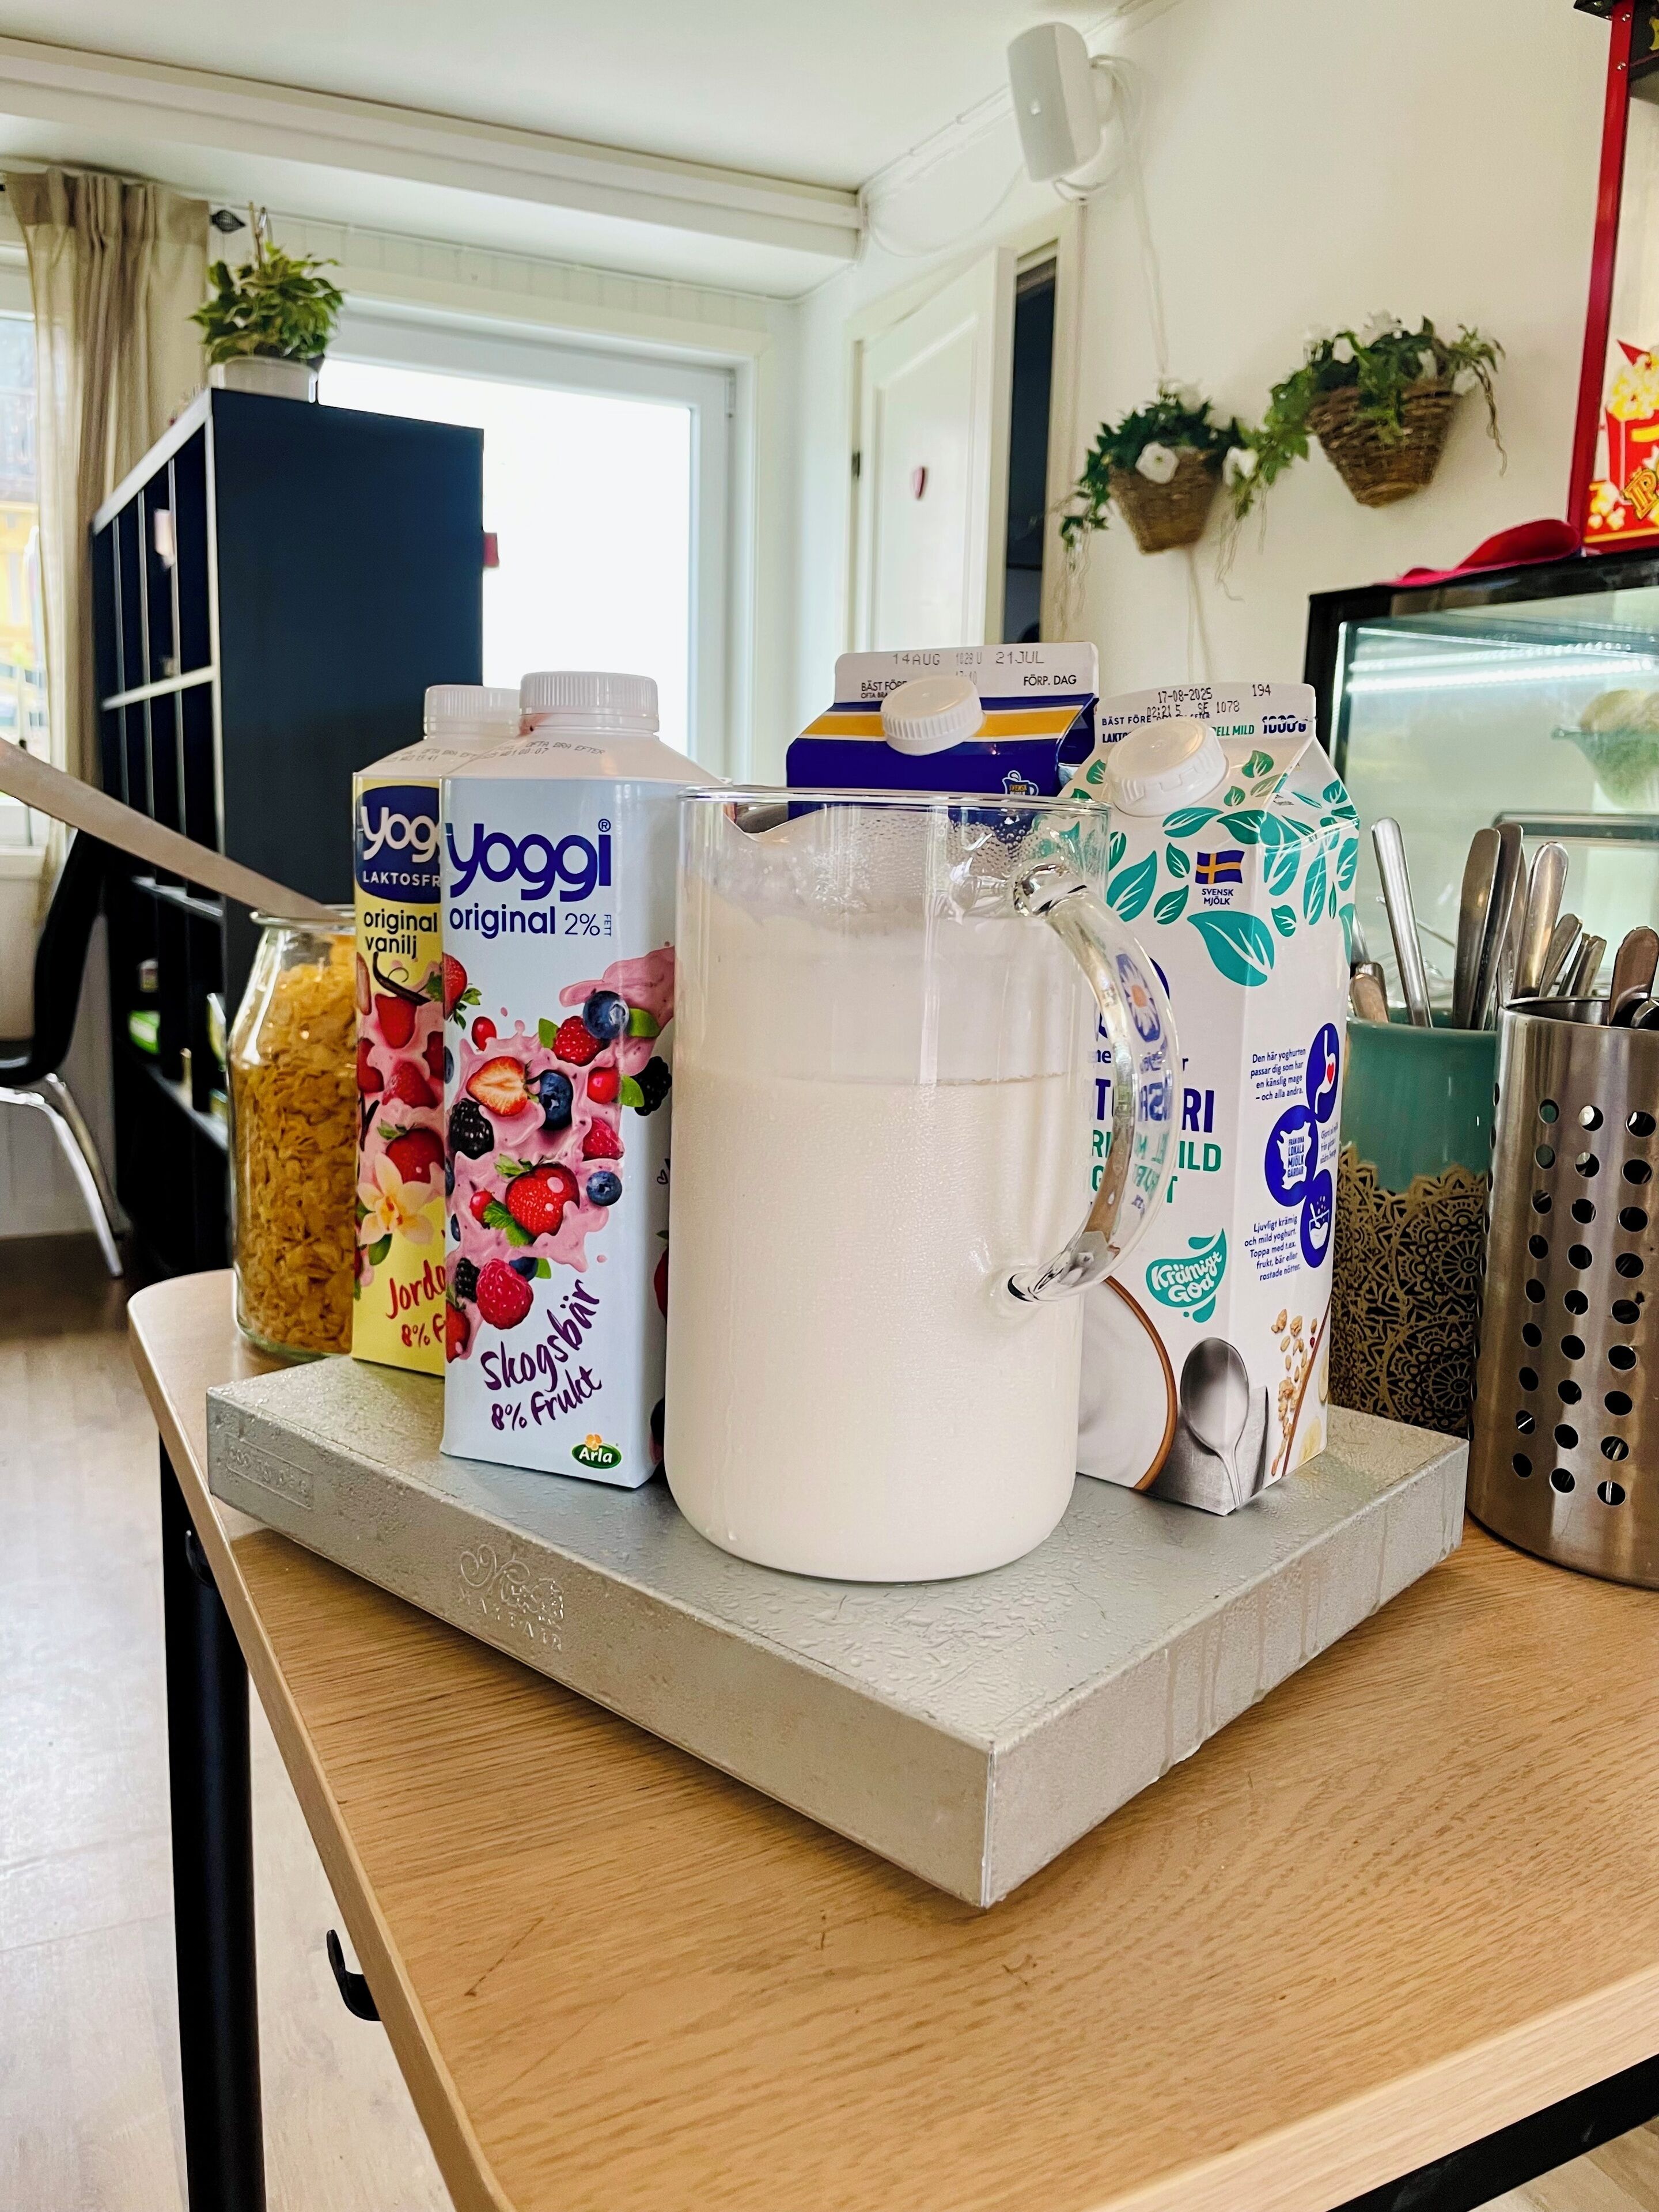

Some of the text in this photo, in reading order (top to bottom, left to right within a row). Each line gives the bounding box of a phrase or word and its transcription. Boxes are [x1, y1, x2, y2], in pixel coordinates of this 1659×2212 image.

[861, 680, 882, 691] BÄST
[1023, 674, 1077, 686] FÖRP. DAG
[1158, 687, 1213, 704] 17-08-2025
[1252, 684, 1271, 696] 194
[1216, 700, 1240, 713] 1078
[1102, 716, 1124, 726] BÄST
[1128, 714, 1152, 724] FÖRE
[1232, 725, 1255, 735] MILD
[363, 870, 441, 888] LAKTOSFR
[1202, 888, 1234, 896] SVENSK
[1203, 896, 1230, 906] MJÖLK
[363, 908, 438, 935] original
[449, 903, 601, 939] original 2%
[604, 914, 612, 937] FETT
[365, 934, 417, 960] vanilj
[1252, 1048, 1306, 1063] Den här yoghurten
[1251, 1060, 1304, 1080] passar dig som har
[1266, 1075, 1286, 1087] känslig
[1287, 1075, 1302, 1085] mage
[1262, 1090, 1273, 1101] och
[1274, 1089, 1285, 1099] alla
[1286, 1085, 1304, 1096] andra.
[1253, 1214, 1297, 1233] Ljuvligt krämig
[1244, 1228, 1297, 1247] och mild yoghurt.
[1249, 1248, 1270, 1259] Toppa
[1271, 1242, 1284, 1253] med
[1256, 1251, 1298, 1270] frukt, bär eller
[1151, 1251, 1222, 1291] Krämigt
[1260, 1263, 1301, 1281] rostade nötter.
[402, 1323, 431, 1348] 8%
[480, 1278, 600, 1393] Skogsbär
[491, 1402, 528, 1431] 8%
[578, 1446, 613, 1463] Arla
